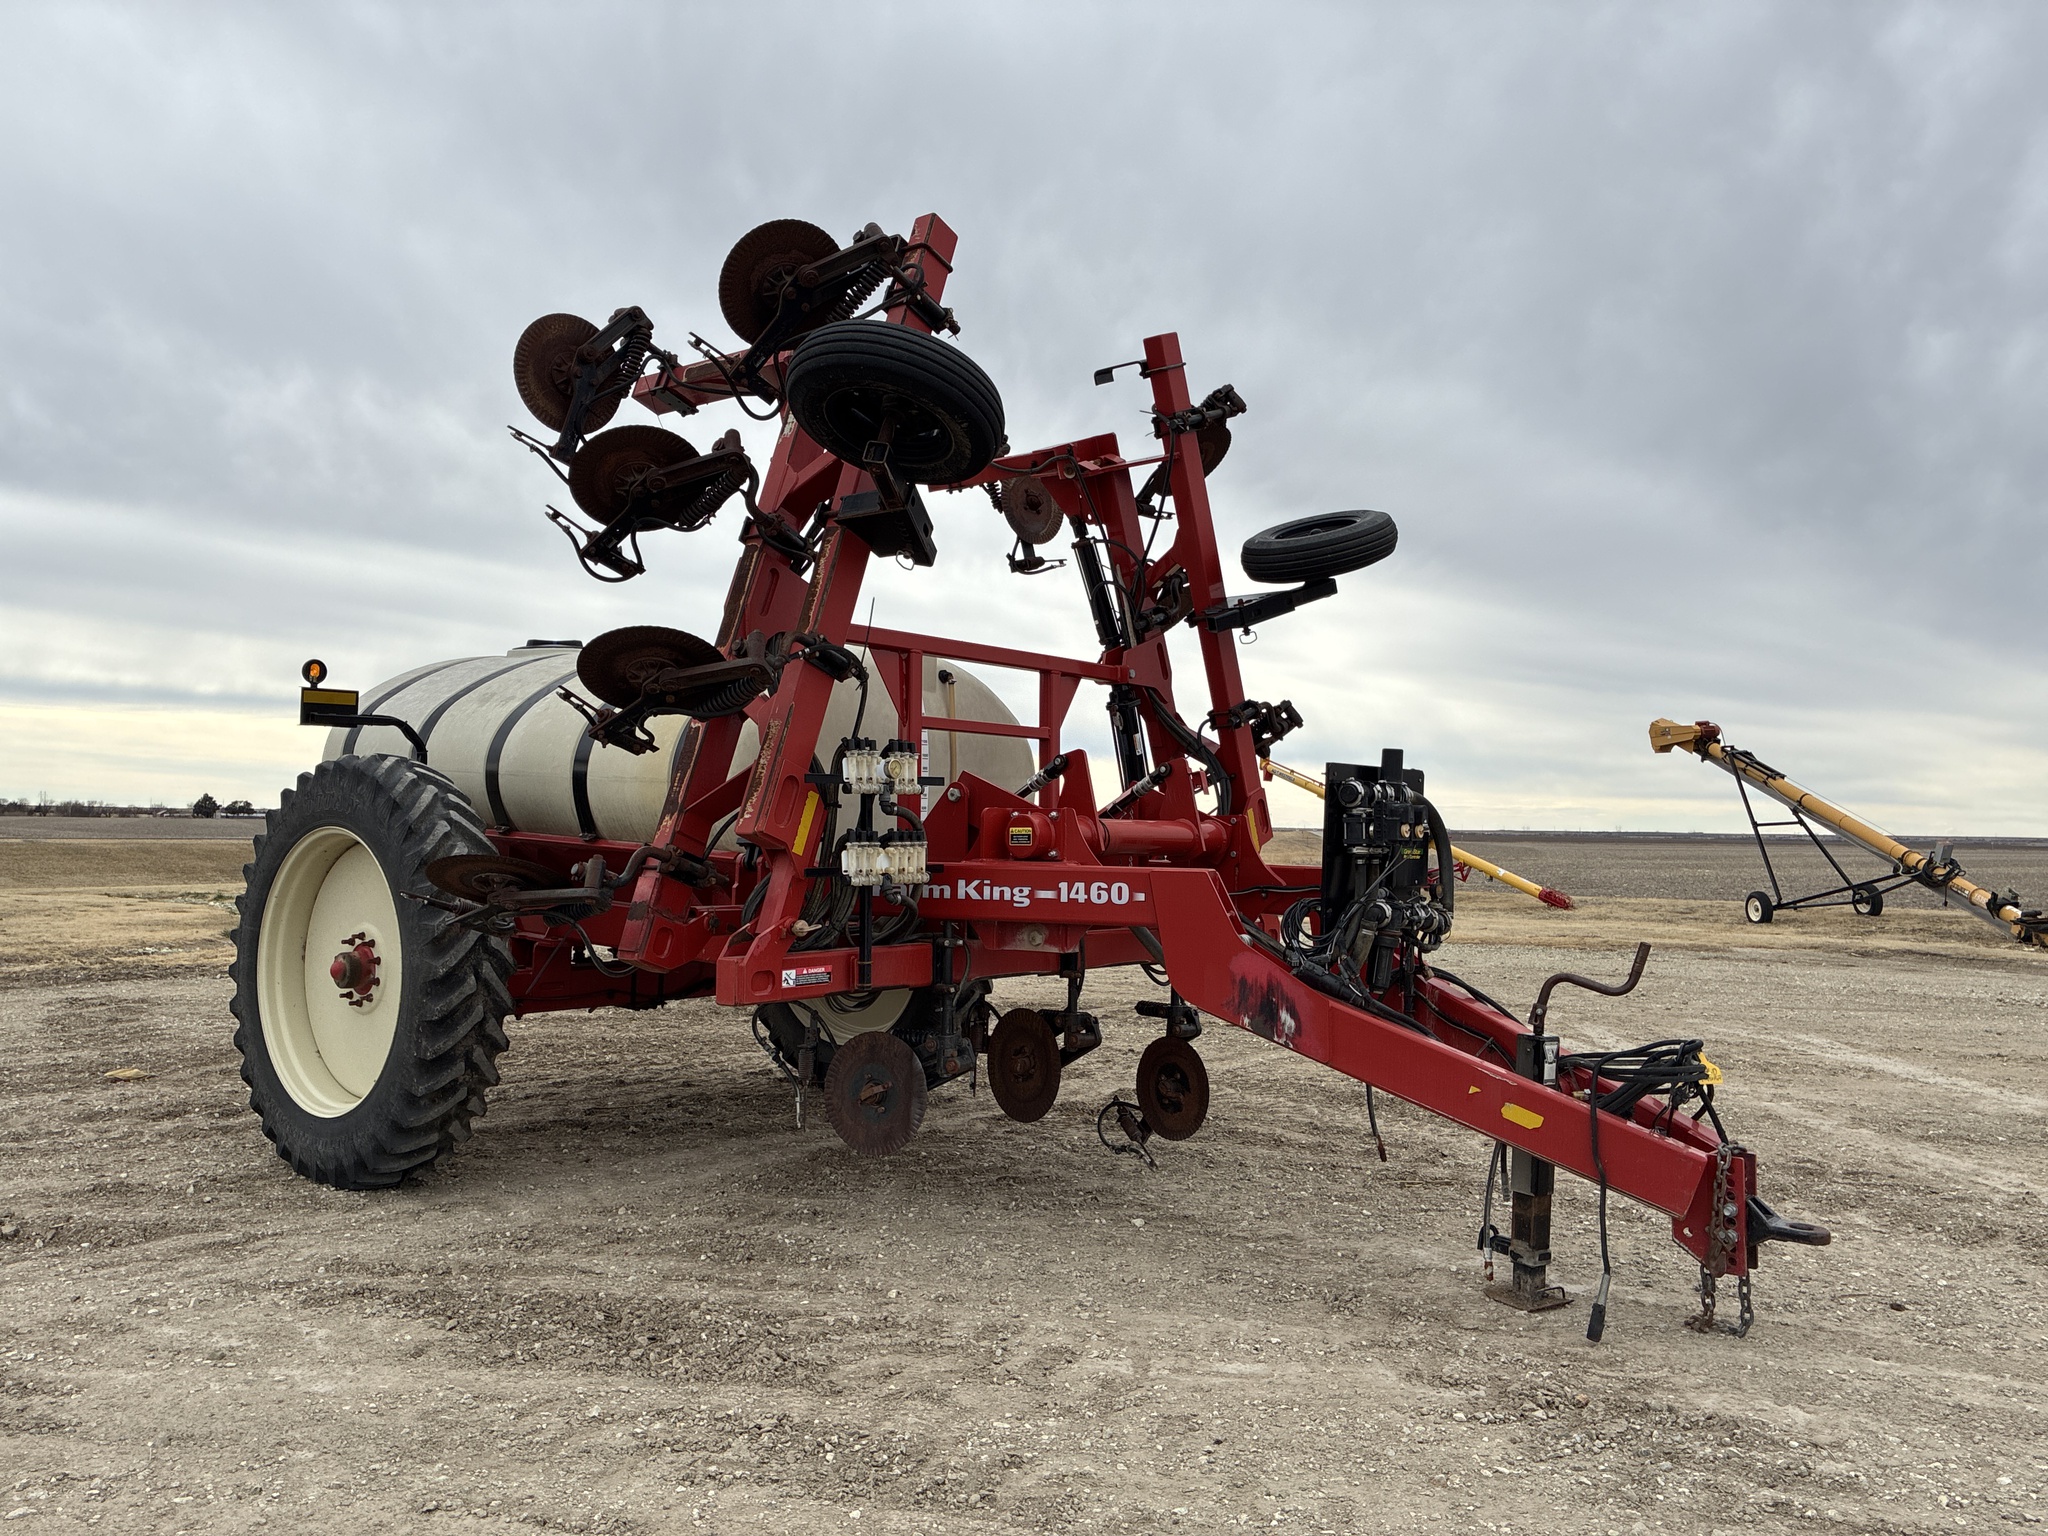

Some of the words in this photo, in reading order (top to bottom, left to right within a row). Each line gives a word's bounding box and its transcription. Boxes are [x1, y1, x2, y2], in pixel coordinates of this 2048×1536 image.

[873, 883, 951, 899] am
[957, 879, 1032, 908] King
[1058, 881, 1130, 905] 1460
